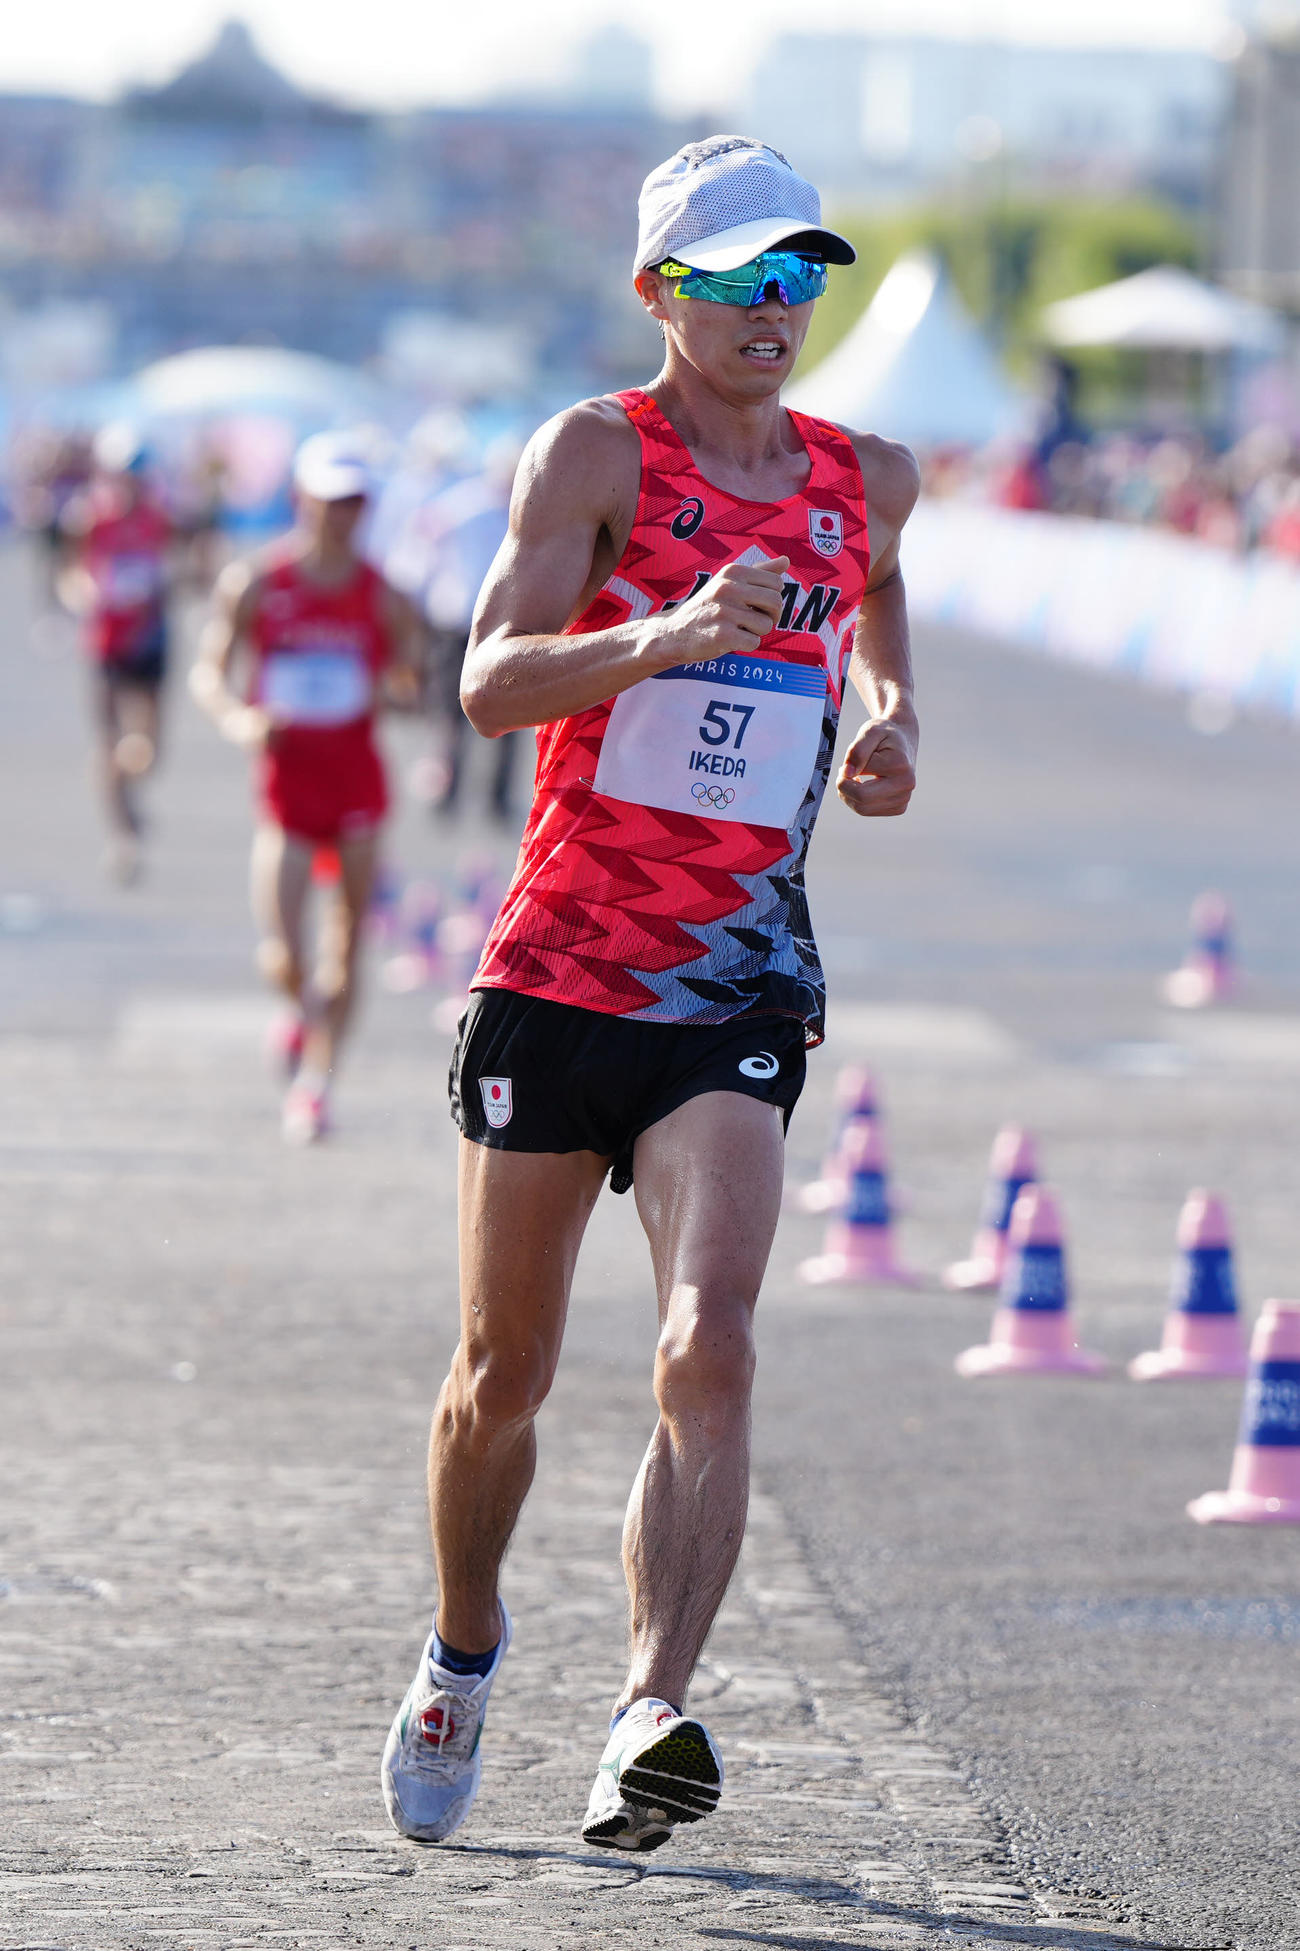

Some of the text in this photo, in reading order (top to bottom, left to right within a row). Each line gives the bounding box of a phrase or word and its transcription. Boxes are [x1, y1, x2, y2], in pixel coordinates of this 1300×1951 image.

[742, 665, 784, 684] 2024
[699, 700, 757, 750] 57
[688, 750, 747, 779] IKEDA
